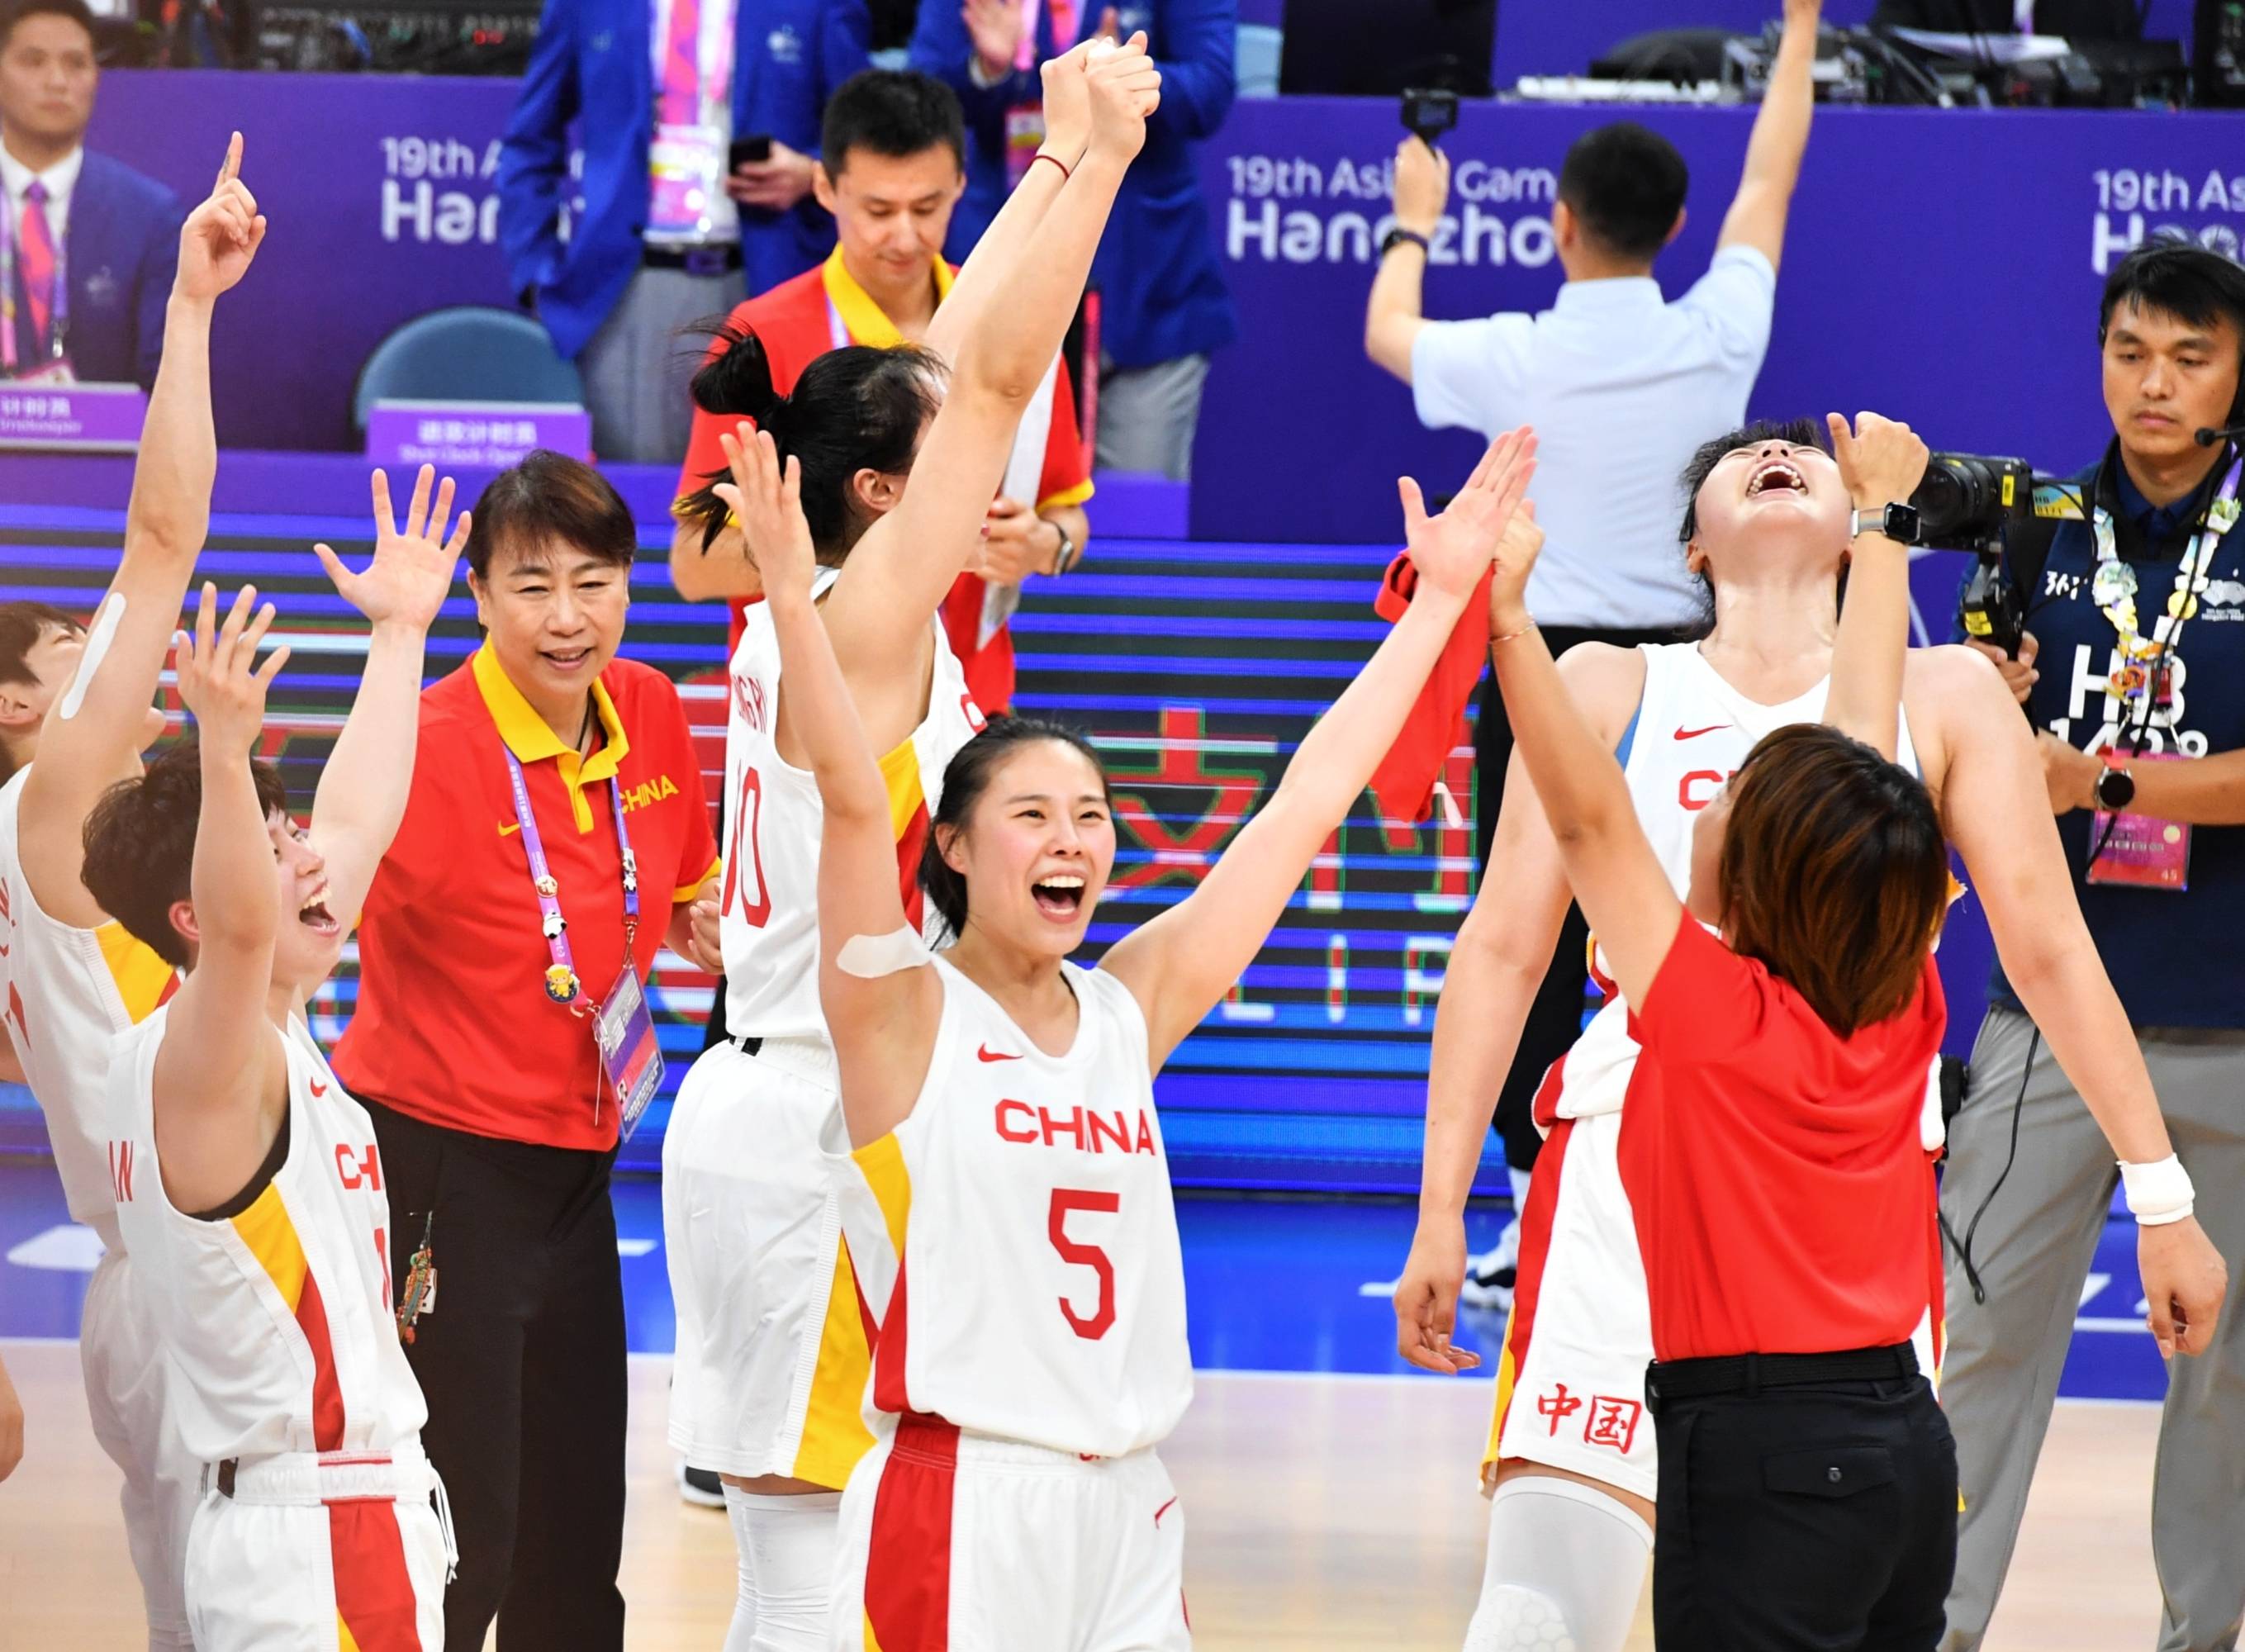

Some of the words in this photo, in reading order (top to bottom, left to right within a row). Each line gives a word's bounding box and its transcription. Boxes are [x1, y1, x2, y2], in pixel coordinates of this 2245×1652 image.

[380, 136, 475, 179] 19th
[1227, 154, 1323, 198] 19th
[1328, 157, 1397, 200] Asi
[1454, 159, 1558, 203] Gam
[2092, 168, 2190, 211] 19th
[2195, 169, 2245, 212] As
[1226, 197, 1558, 268] Hanzho
[995, 1099, 1156, 1156] CHNA
[1048, 1187, 1120, 1341] 5
[1537, 1383, 1642, 1455] 中国
